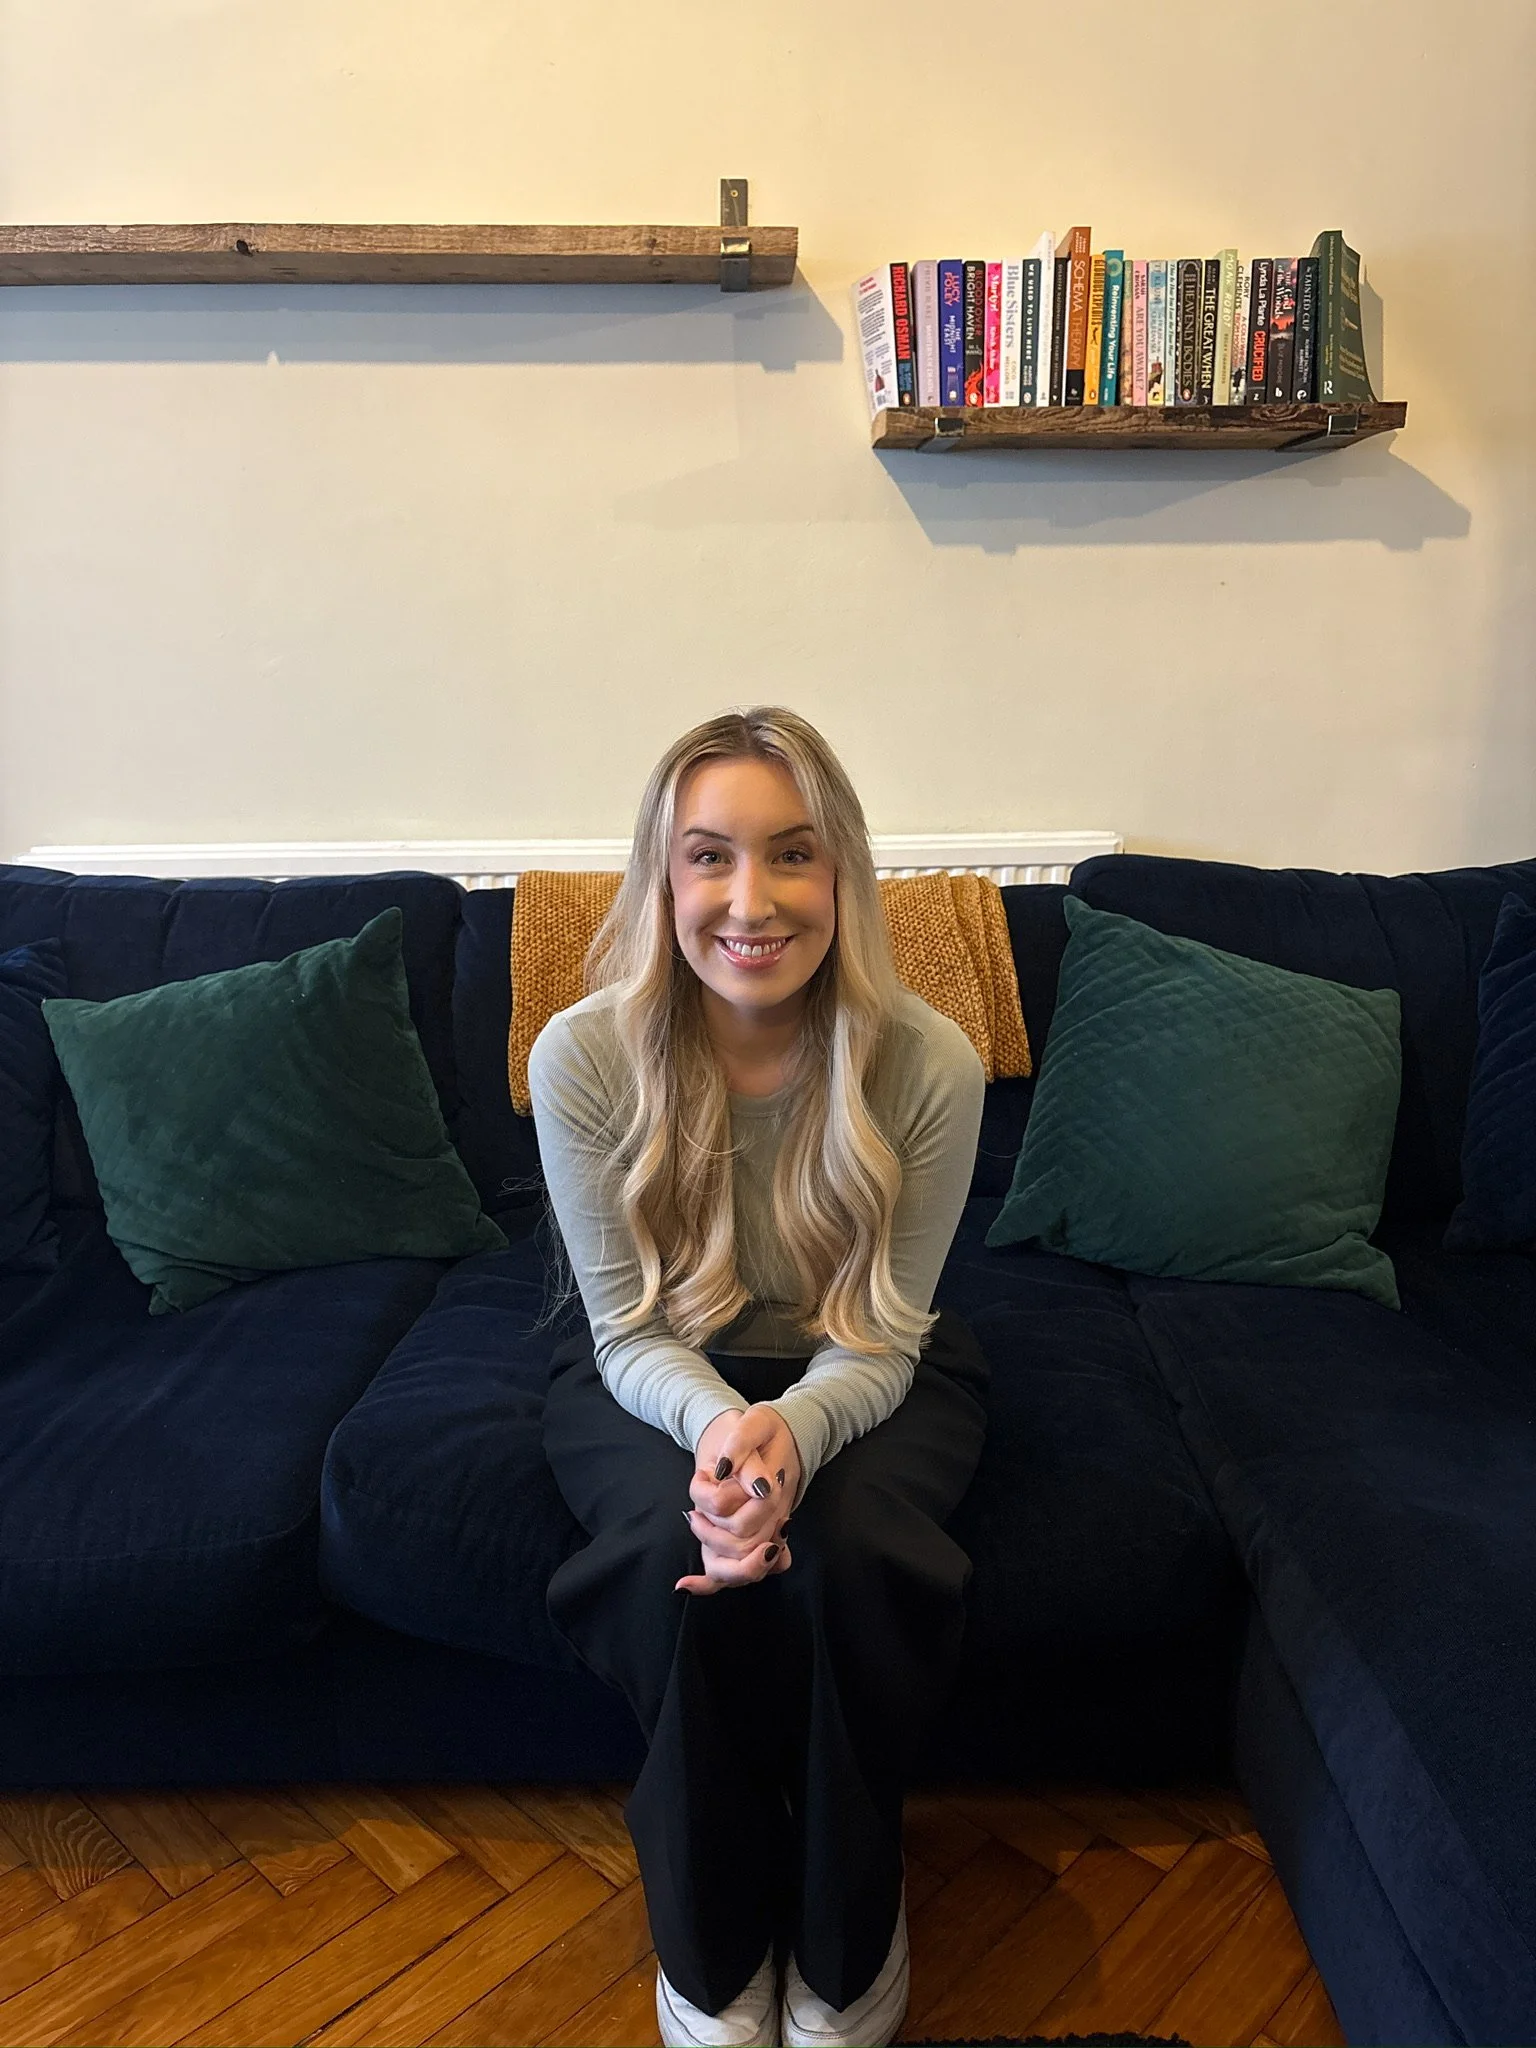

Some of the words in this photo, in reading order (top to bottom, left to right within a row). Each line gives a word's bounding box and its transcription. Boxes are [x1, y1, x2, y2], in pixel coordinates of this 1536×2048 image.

[966, 266, 976, 302] BRIGHT
[1007, 265, 1019, 298] Blue
[1027, 263, 1035, 276] WE
[1093, 259, 1105, 293] GLORIOUS
[1225, 253, 1235, 286] MONK
[1258, 261, 1269, 287] Lynda
[1276, 272, 1285, 286] the
[1277, 264, 1285, 272] of
[944, 272, 953, 306] FOLEY
[951, 275, 961, 303] LUCY
[975, 269, 984, 304] BLOOD
[1027, 279, 1035, 301] USED
[1072, 260, 1086, 313] SCHEMA
[1204, 287, 1216, 311] THE
[1234, 265, 1245, 309] CLEMENTS
[1243, 276, 1251, 299] RORY
[1258, 287, 1268, 299] La
[1274, 287, 1285, 319] Woods
[1281, 289, 1293, 310] God
[1303, 272, 1312, 310] TAINTED
[966, 306, 975, 340] HAVEN
[974, 307, 983, 336] OVER
[1005, 300, 1018, 348] Sisters
[1026, 304, 1034, 315] TO
[1091, 293, 1103, 326] EXPLOITS
[1108, 284, 1120, 339] Reinventing
[1136, 306, 1144, 325] ARE
[1184, 284, 1195, 343] HEAVENLY
[1223, 292, 1233, 328] ROBOT
[1233, 312, 1241, 331] FROM
[1256, 300, 1267, 326] Plante
[1302, 313, 1310, 332] CUP
[896, 319, 911, 360] OSMAN
[1070, 315, 1082, 368] THERAPY
[1136, 327, 1144, 348] YOU
[1202, 312, 1215, 351] GREAT
[1108, 339, 1117, 362] Your
[1183, 345, 1194, 388] BODIES
[1252, 330, 1266, 382] CRUCIFIED
[1107, 362, 1115, 380] Life
[1135, 350, 1144, 391] AWAKE?
[1201, 351, 1213, 389] WHEN
